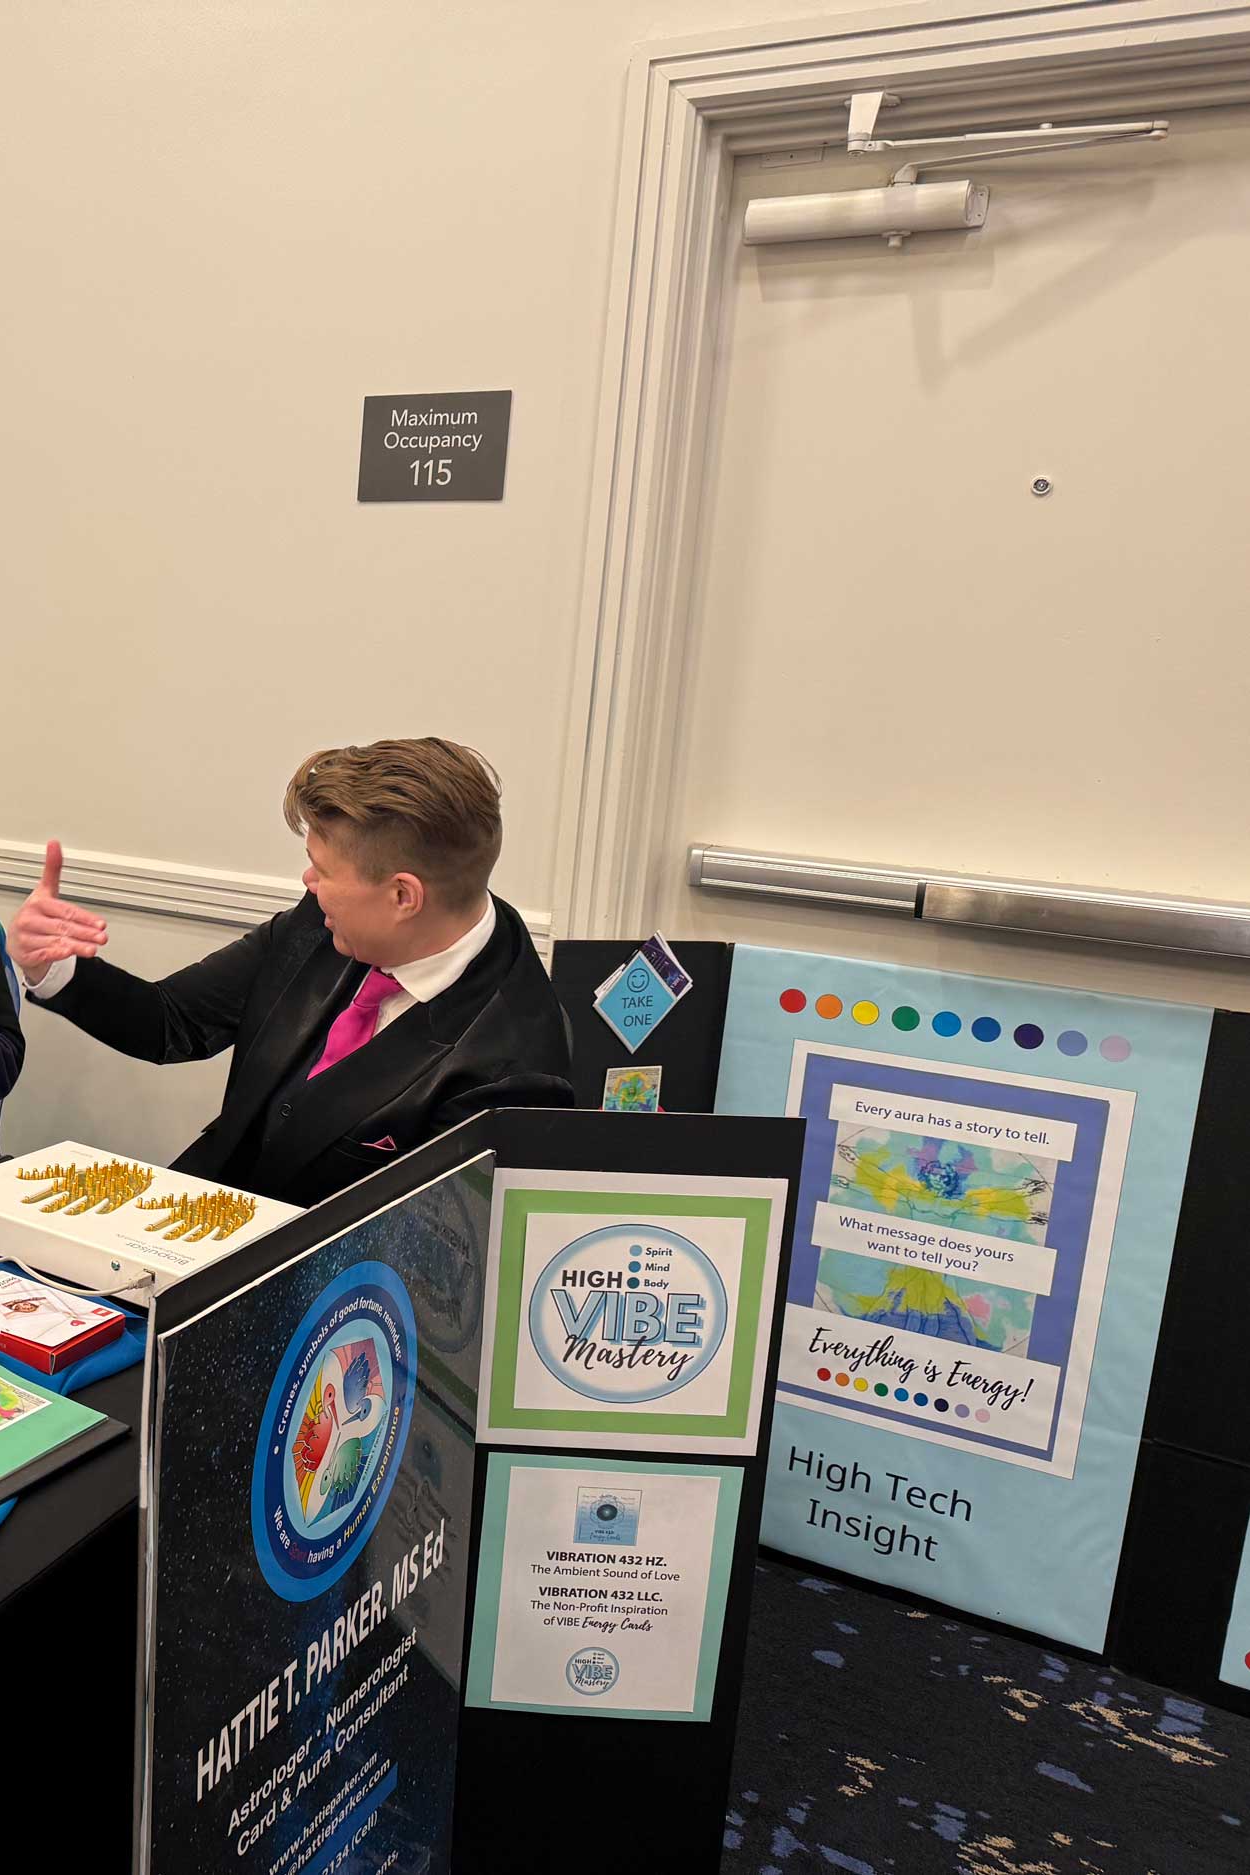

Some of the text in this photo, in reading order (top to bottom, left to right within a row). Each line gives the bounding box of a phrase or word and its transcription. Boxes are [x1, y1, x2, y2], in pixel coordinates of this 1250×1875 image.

[391, 408, 478, 427] Maximum
[384, 432, 483, 454] Occupancy
[410, 459, 452, 486] 115
[622, 996, 654, 1009] TAKE
[624, 1014, 652, 1027] ONE
[855, 1101, 1050, 1145] Every aura has a story to tell.
[839, 1216, 1014, 1262] What message does yours
[126, 1242, 189, 1266] Biopulsar
[645, 1247, 673, 1258] Spirit
[867, 1240, 978, 1272] want to tell you?
[561, 1270, 670, 1290] HIGH Body
[644, 1262, 670, 1273] Mind
[550, 1288, 707, 1348] VIBE
[278, 1380, 300, 1435] Cranes,
[298, 1324, 329, 1377] symbols
[329, 1310, 338, 1328] of
[338, 1297, 359, 1322] good
[358, 1296, 384, 1318] fortune,
[382, 1310, 400, 1345] remind
[562, 1334, 695, 1382] Mastery
[808, 1327, 1035, 1411] Everything is Energy!
[274, 1505, 283, 1530] We
[280, 1530, 290, 1550] are
[307, 1544, 335, 1564] having
[336, 1538, 342, 1550] a
[344, 1496, 372, 1543] Human
[370, 1406, 400, 1494] Experience
[788, 1446, 972, 1522] High Tech
[806, 1498, 940, 1562] Insight
[546, 1550, 668, 1567] VIBRATION 432 HZ.
[531, 1564, 680, 1582] The Ambient Sound of Love
[538, 1586, 663, 1602] VIBRATION 432 LLC.
[530, 1600, 668, 1616] The Non-Profit Inspiration
[543, 1616, 654, 1634] of VIBE Energy Cards
[197, 1675, 280, 1802] HATTIE
[284, 1658, 300, 1714] T.
[392, 1544, 420, 1612] MS
[423, 1518, 445, 1581] Ed
[572, 1664, 614, 1680] VIBE
[574, 1678, 610, 1690] Mastery
[228, 1627, 418, 1837] Astrologer Numerologist
[237, 1664, 409, 1857] Card & Aura Consultant
[352, 1810, 378, 1851] (Cell)
